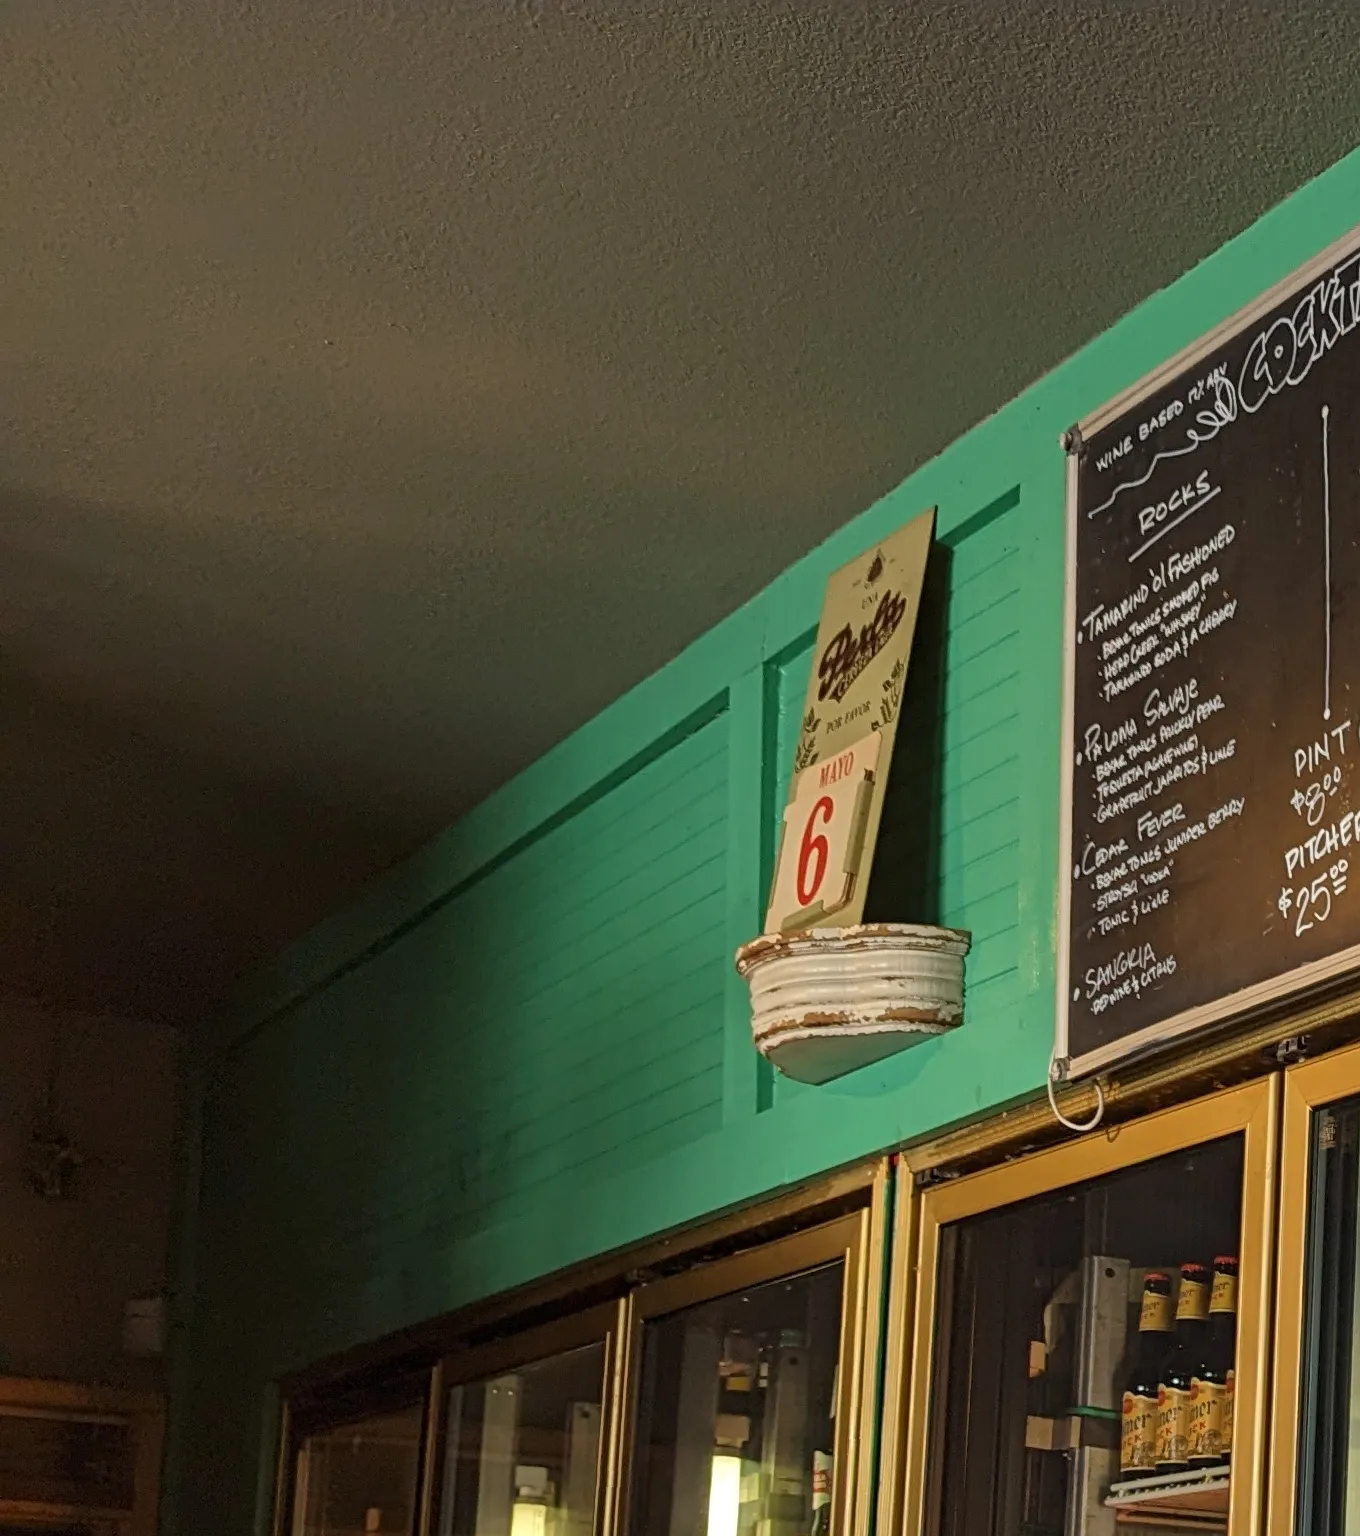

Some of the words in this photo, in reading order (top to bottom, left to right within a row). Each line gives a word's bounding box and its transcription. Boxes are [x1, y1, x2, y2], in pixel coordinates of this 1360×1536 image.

[1096, 438, 1133, 472] WINE
[1139, 401, 1184, 441] BASED
[1138, 470, 1211, 535] ROCKS
[1082, 584, 1149, 641] TAMARIND
[1168, 524, 1236, 583] FASHIONED
[1085, 719, 1138, 762] PALOMA
[1209, 739, 1236, 765] LIME
[1294, 721, 1351, 777] PINT
[819, 752, 853, 788] MAYO
[797, 796, 834, 906] 6
[1082, 838, 1129, 876] CEDAR
[1137, 803, 1186, 841] FEVER
[1098, 910, 1130, 936] TONIC
[1141, 889, 1170, 915] LIME
[1085, 942, 1156, 999] SANGRIA
